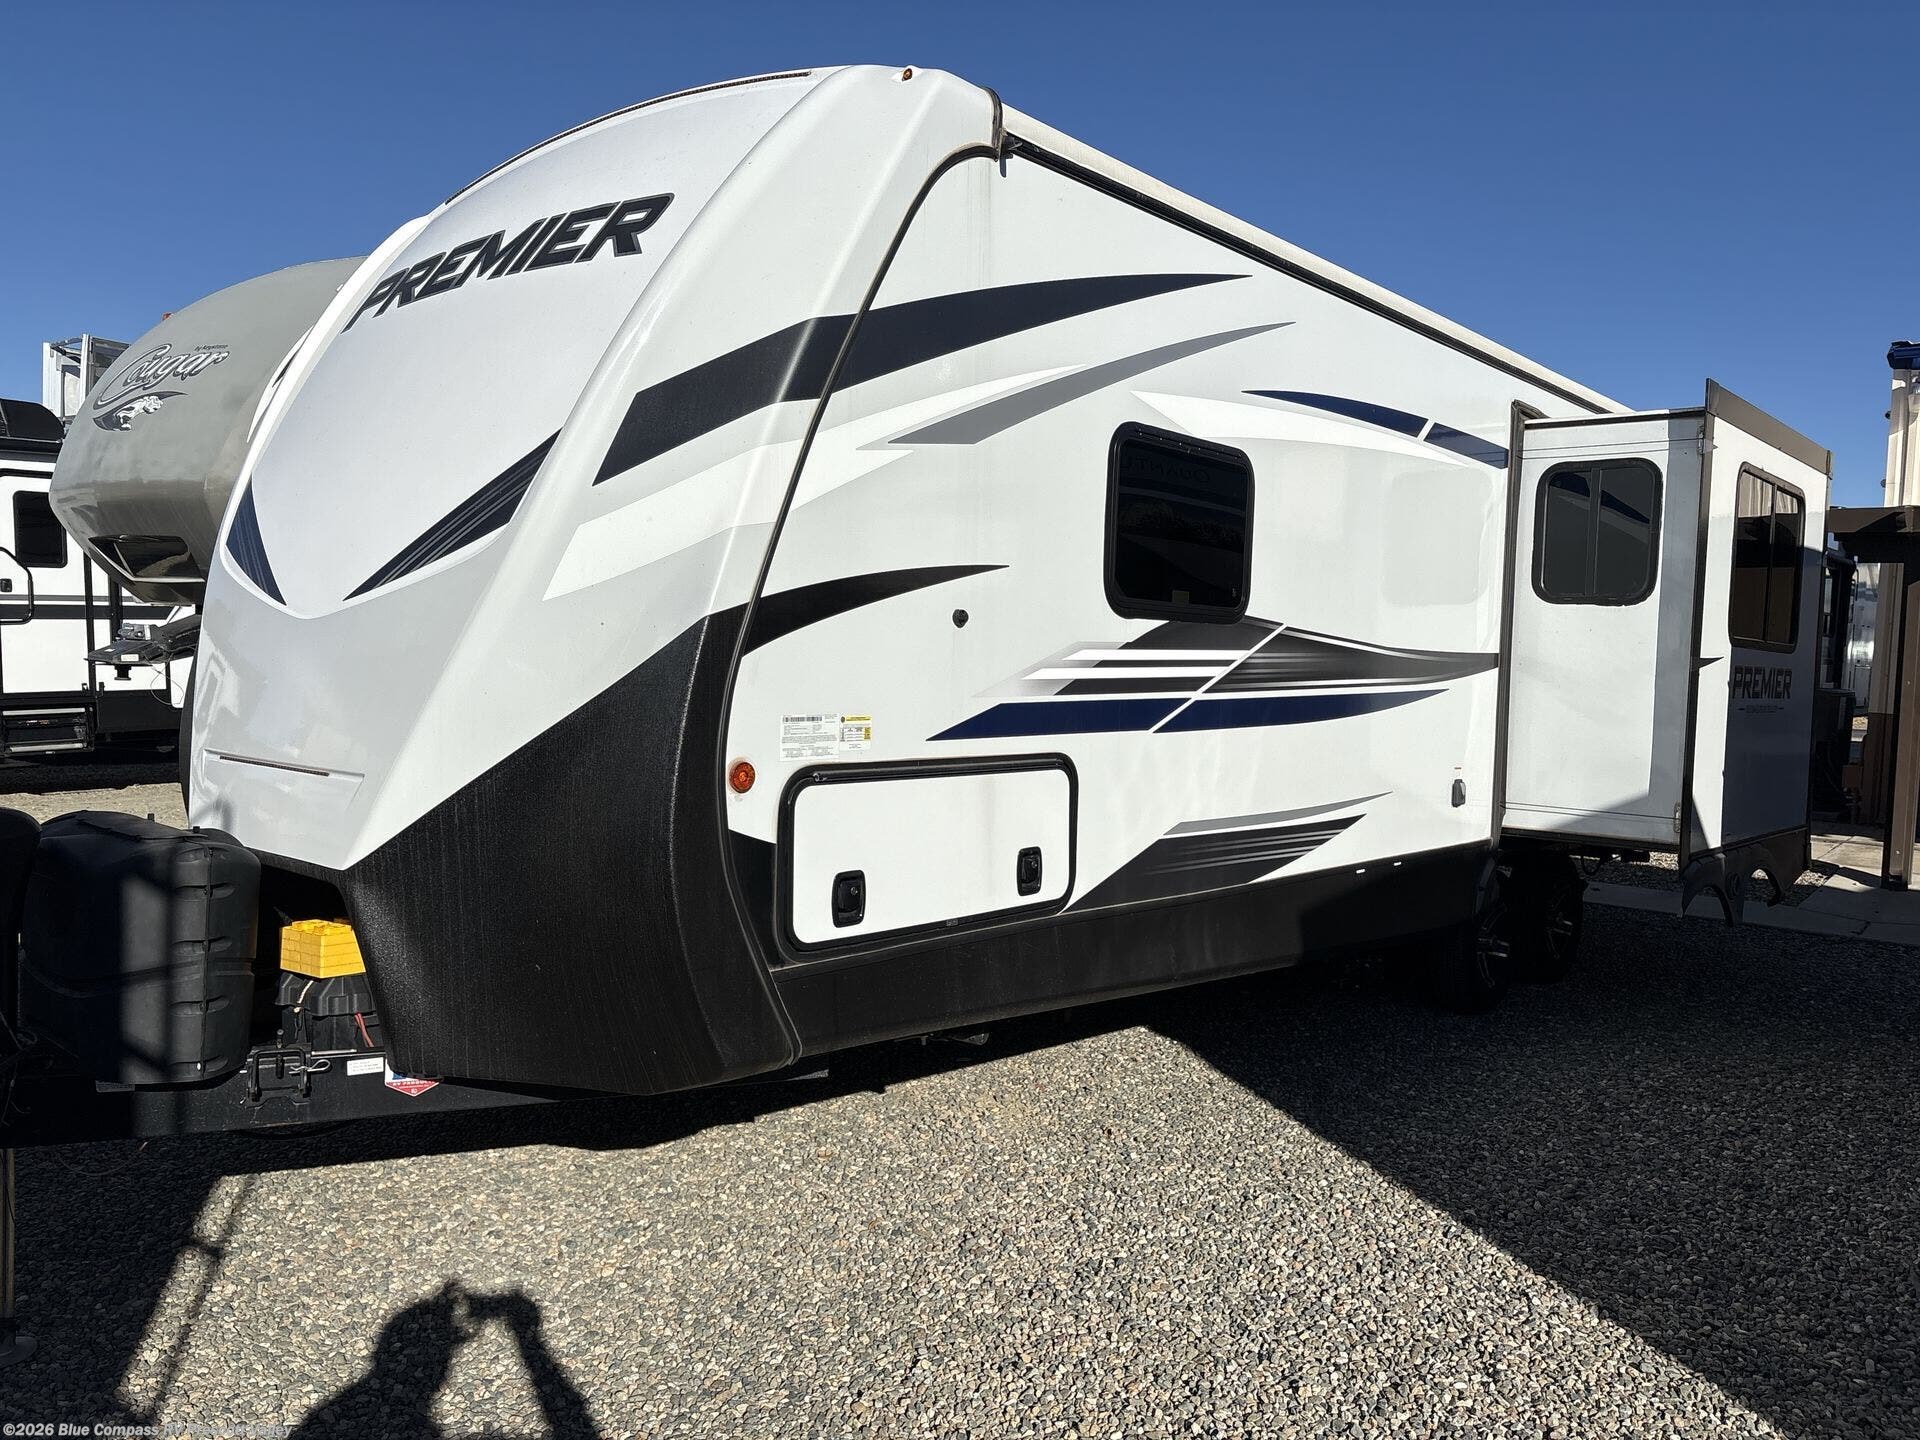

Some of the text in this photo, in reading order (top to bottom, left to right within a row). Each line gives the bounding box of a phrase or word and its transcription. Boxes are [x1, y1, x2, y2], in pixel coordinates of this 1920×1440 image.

[340, 192, 675, 335] PREMIER
[93, 343, 230, 410] Cougar
[1732, 665, 1793, 699] PREMIER
